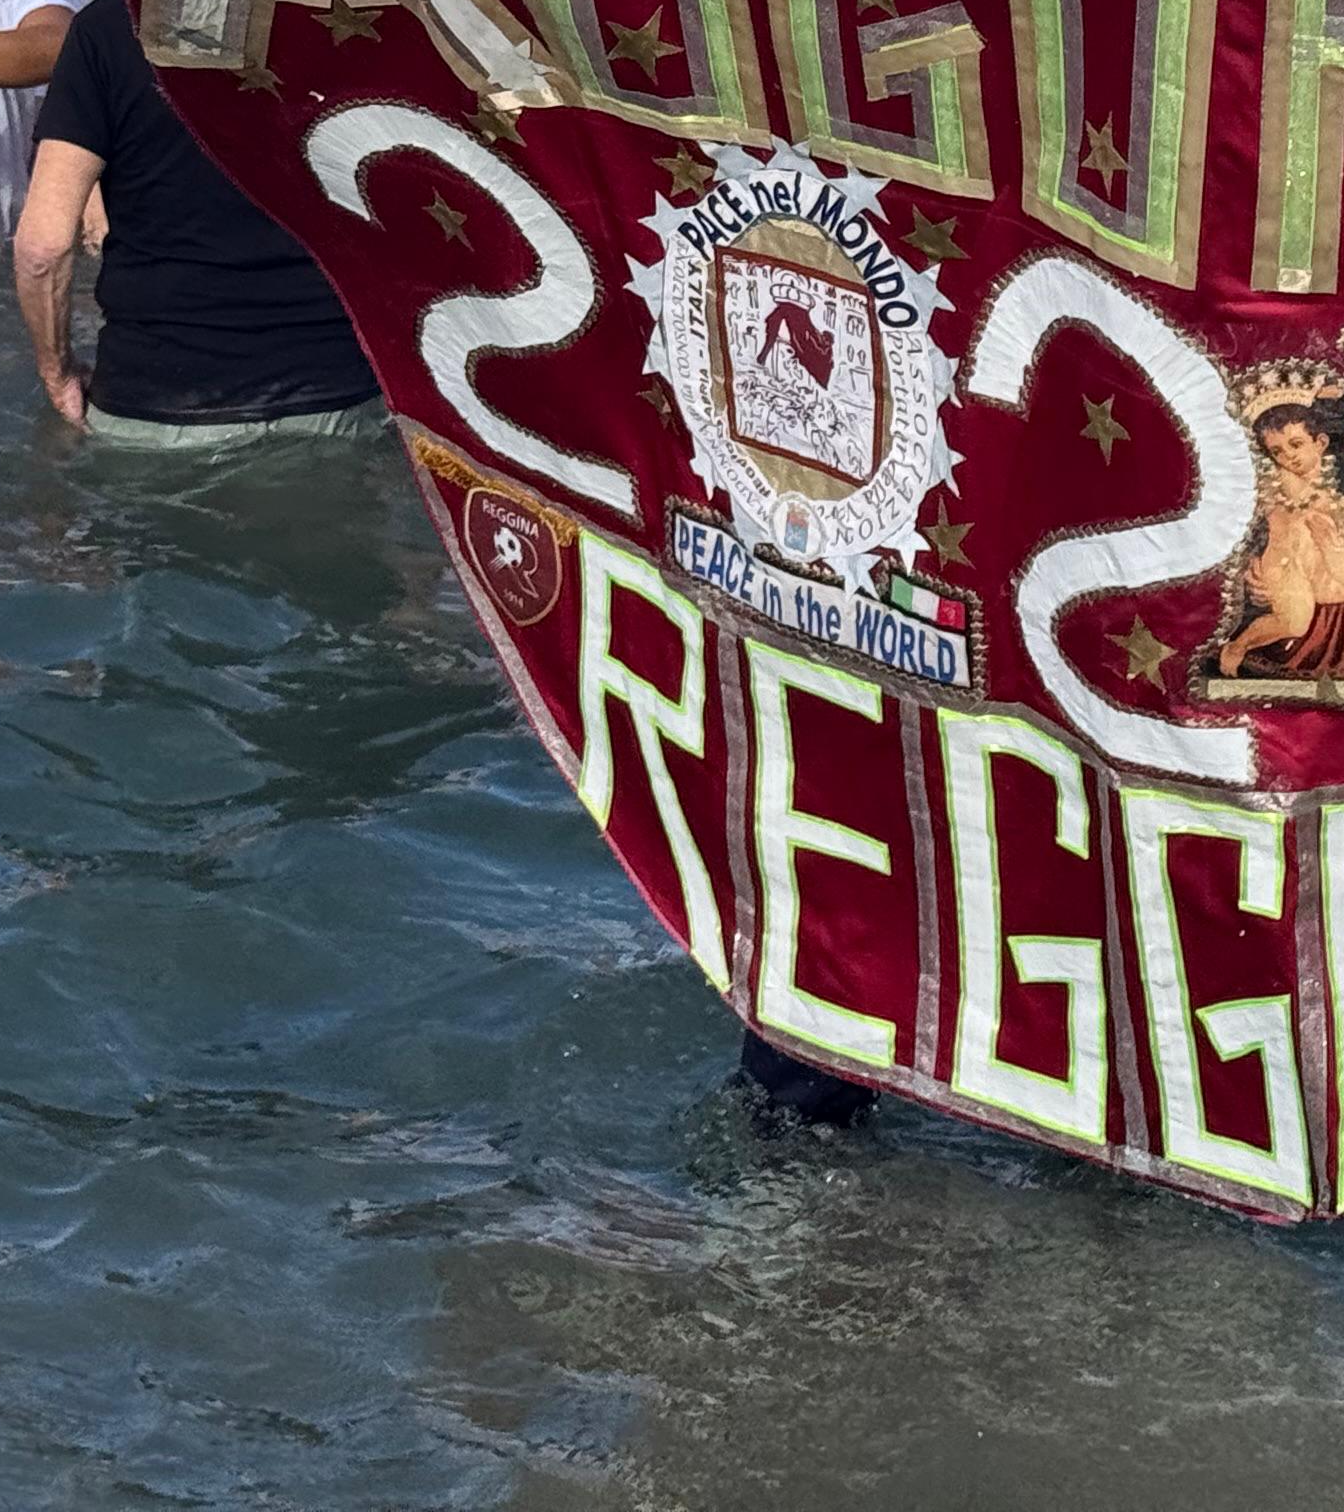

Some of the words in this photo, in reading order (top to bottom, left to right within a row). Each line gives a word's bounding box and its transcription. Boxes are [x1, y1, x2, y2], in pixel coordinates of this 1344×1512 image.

[677, 182, 756, 262] PACE
[749, 171, 803, 215] nel
[806, 184, 920, 329] MONDO
[684, 260, 706, 341] ITALY
[481, 497, 541, 539] REGGINA
[677, 524, 756, 603] PEACE
[761, 568, 784, 624] in
[794, 584, 843, 643] the
[854, 599, 959, 684] WORLD
